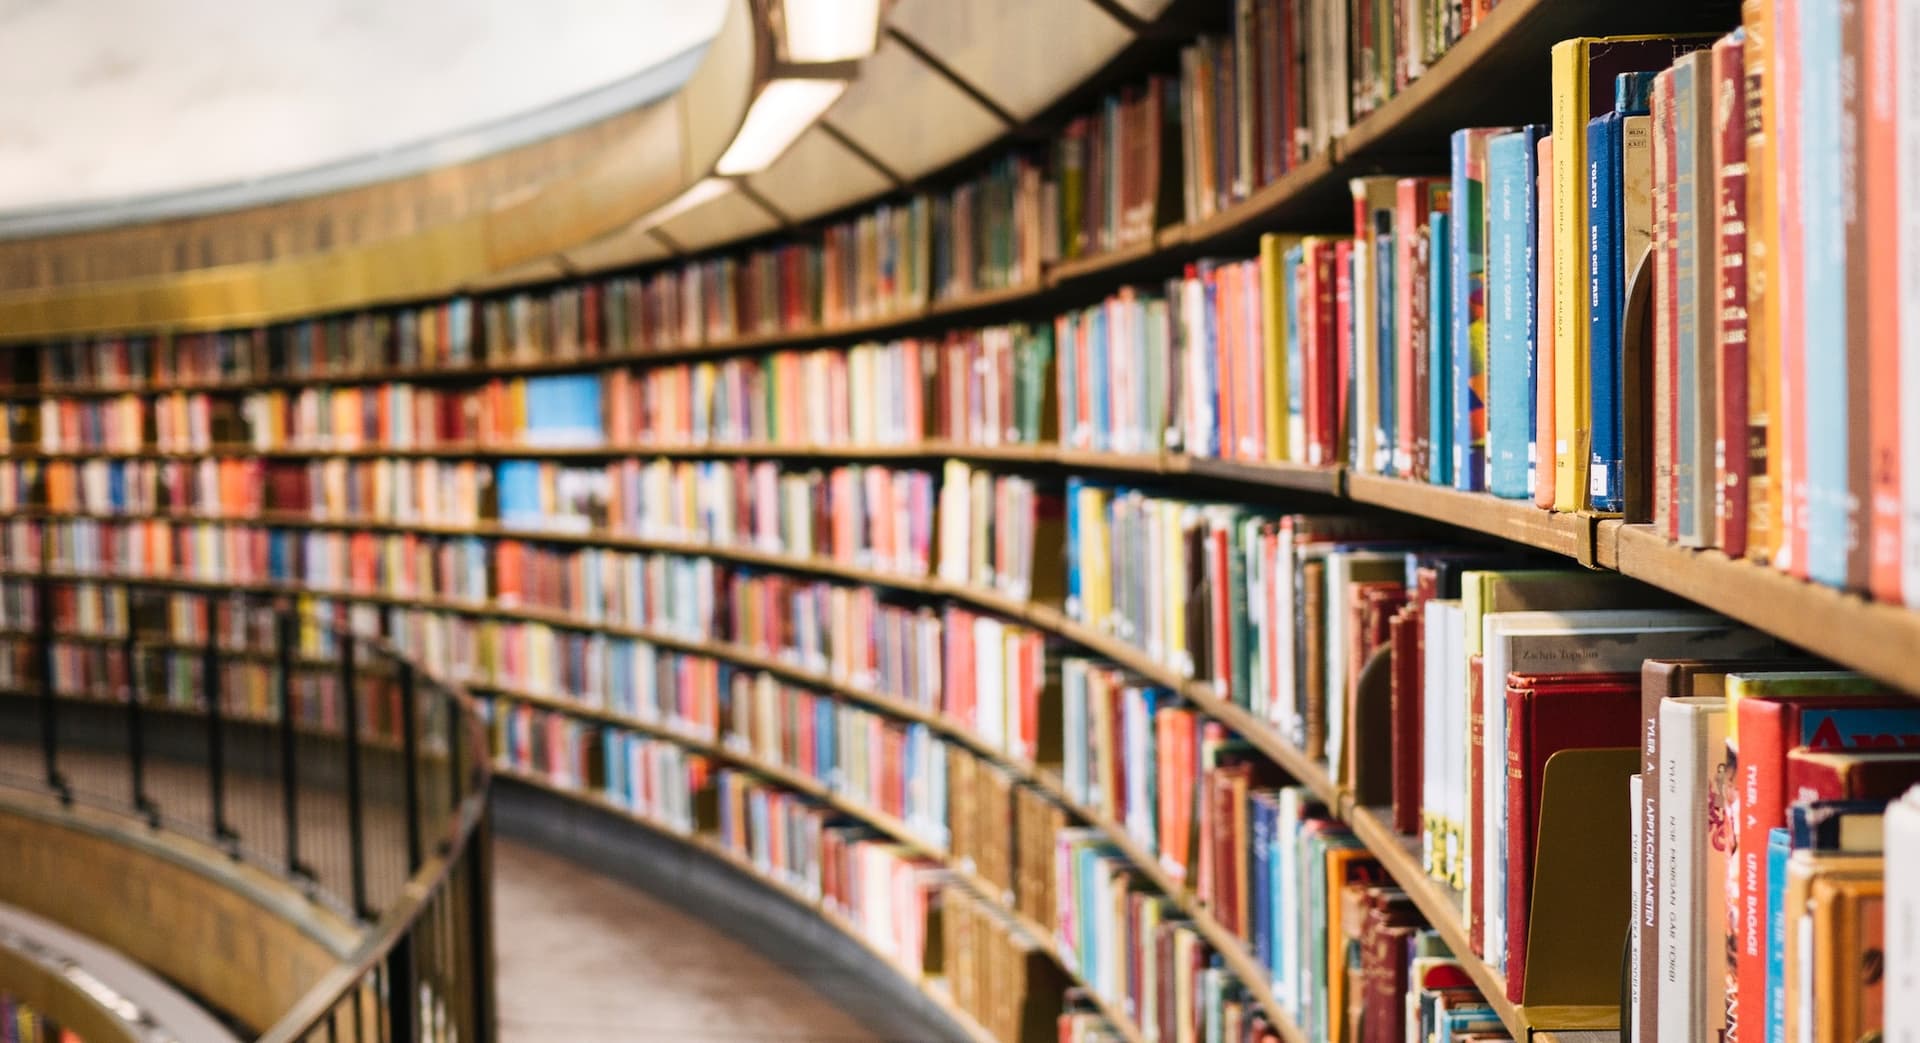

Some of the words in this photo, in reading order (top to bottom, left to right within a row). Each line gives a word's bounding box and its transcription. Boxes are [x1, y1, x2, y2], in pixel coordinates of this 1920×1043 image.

[1560, 648, 1599, 663] Topelius
[1647, 718, 1655, 756] TYLER,
[1647, 762, 1654, 775] A.
[1747, 765, 1757, 807] TYLER,
[1646, 797, 1655, 927] LAPPTÄCKSPLANETEN
[1746, 853, 1757, 892] UTAN
[1746, 895, 1758, 957] BAGAGE
